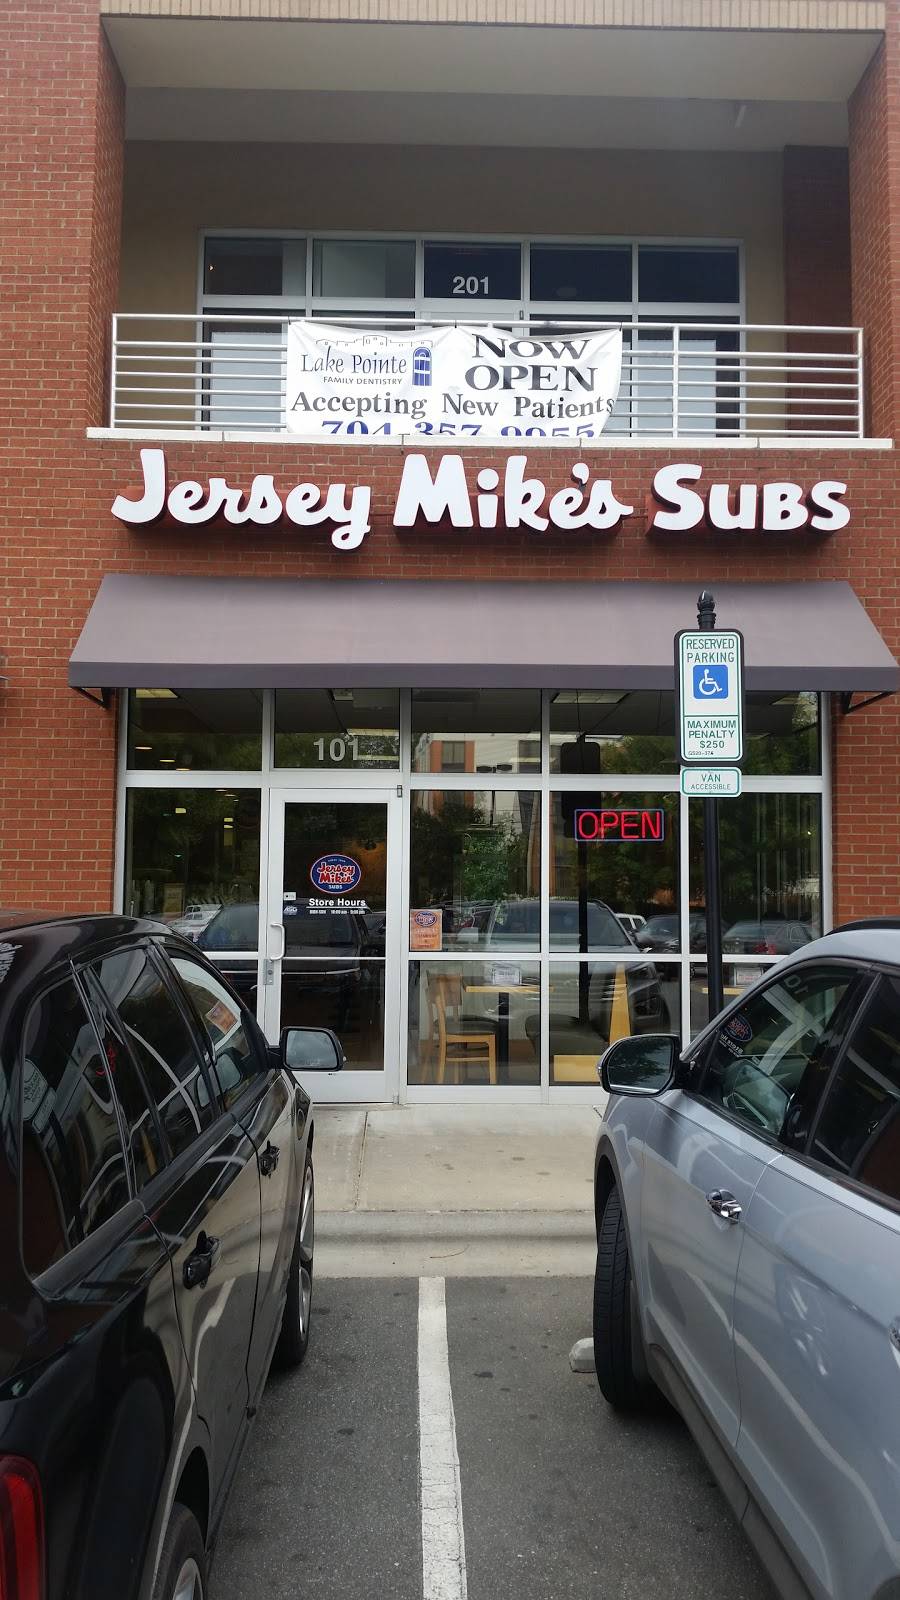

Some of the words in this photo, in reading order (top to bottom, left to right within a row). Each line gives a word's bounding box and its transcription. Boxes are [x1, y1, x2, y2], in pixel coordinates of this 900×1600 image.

[452, 276, 489, 294] 201
[472, 333, 592, 359] NOW
[301, 345, 345, 373] Lake
[352, 351, 407, 374] Pointe
[323, 376, 354, 385] FAMILY
[465, 364, 598, 391] OPEN
[290, 391, 427, 420] Accepting
[442, 393, 499, 416] New
[513, 395, 615, 419] Patients
[111, 448, 372, 550] Jersey
[393, 453, 634, 532] Mike's
[686, 638, 735, 650] RESERVED
[687, 652, 735, 663] PARKING
[687, 720, 737, 729] MAXIMUM
[688, 730, 735, 739] PENALTY
[313, 737, 359, 761] 101
[699, 740, 725, 749] $250
[701, 774, 721, 783] VAN
[578, 811, 661, 839] OPEN
[317, 862, 355, 876] Jersey
[308, 898, 335, 907] Store
[337, 898, 366, 907] Hours
